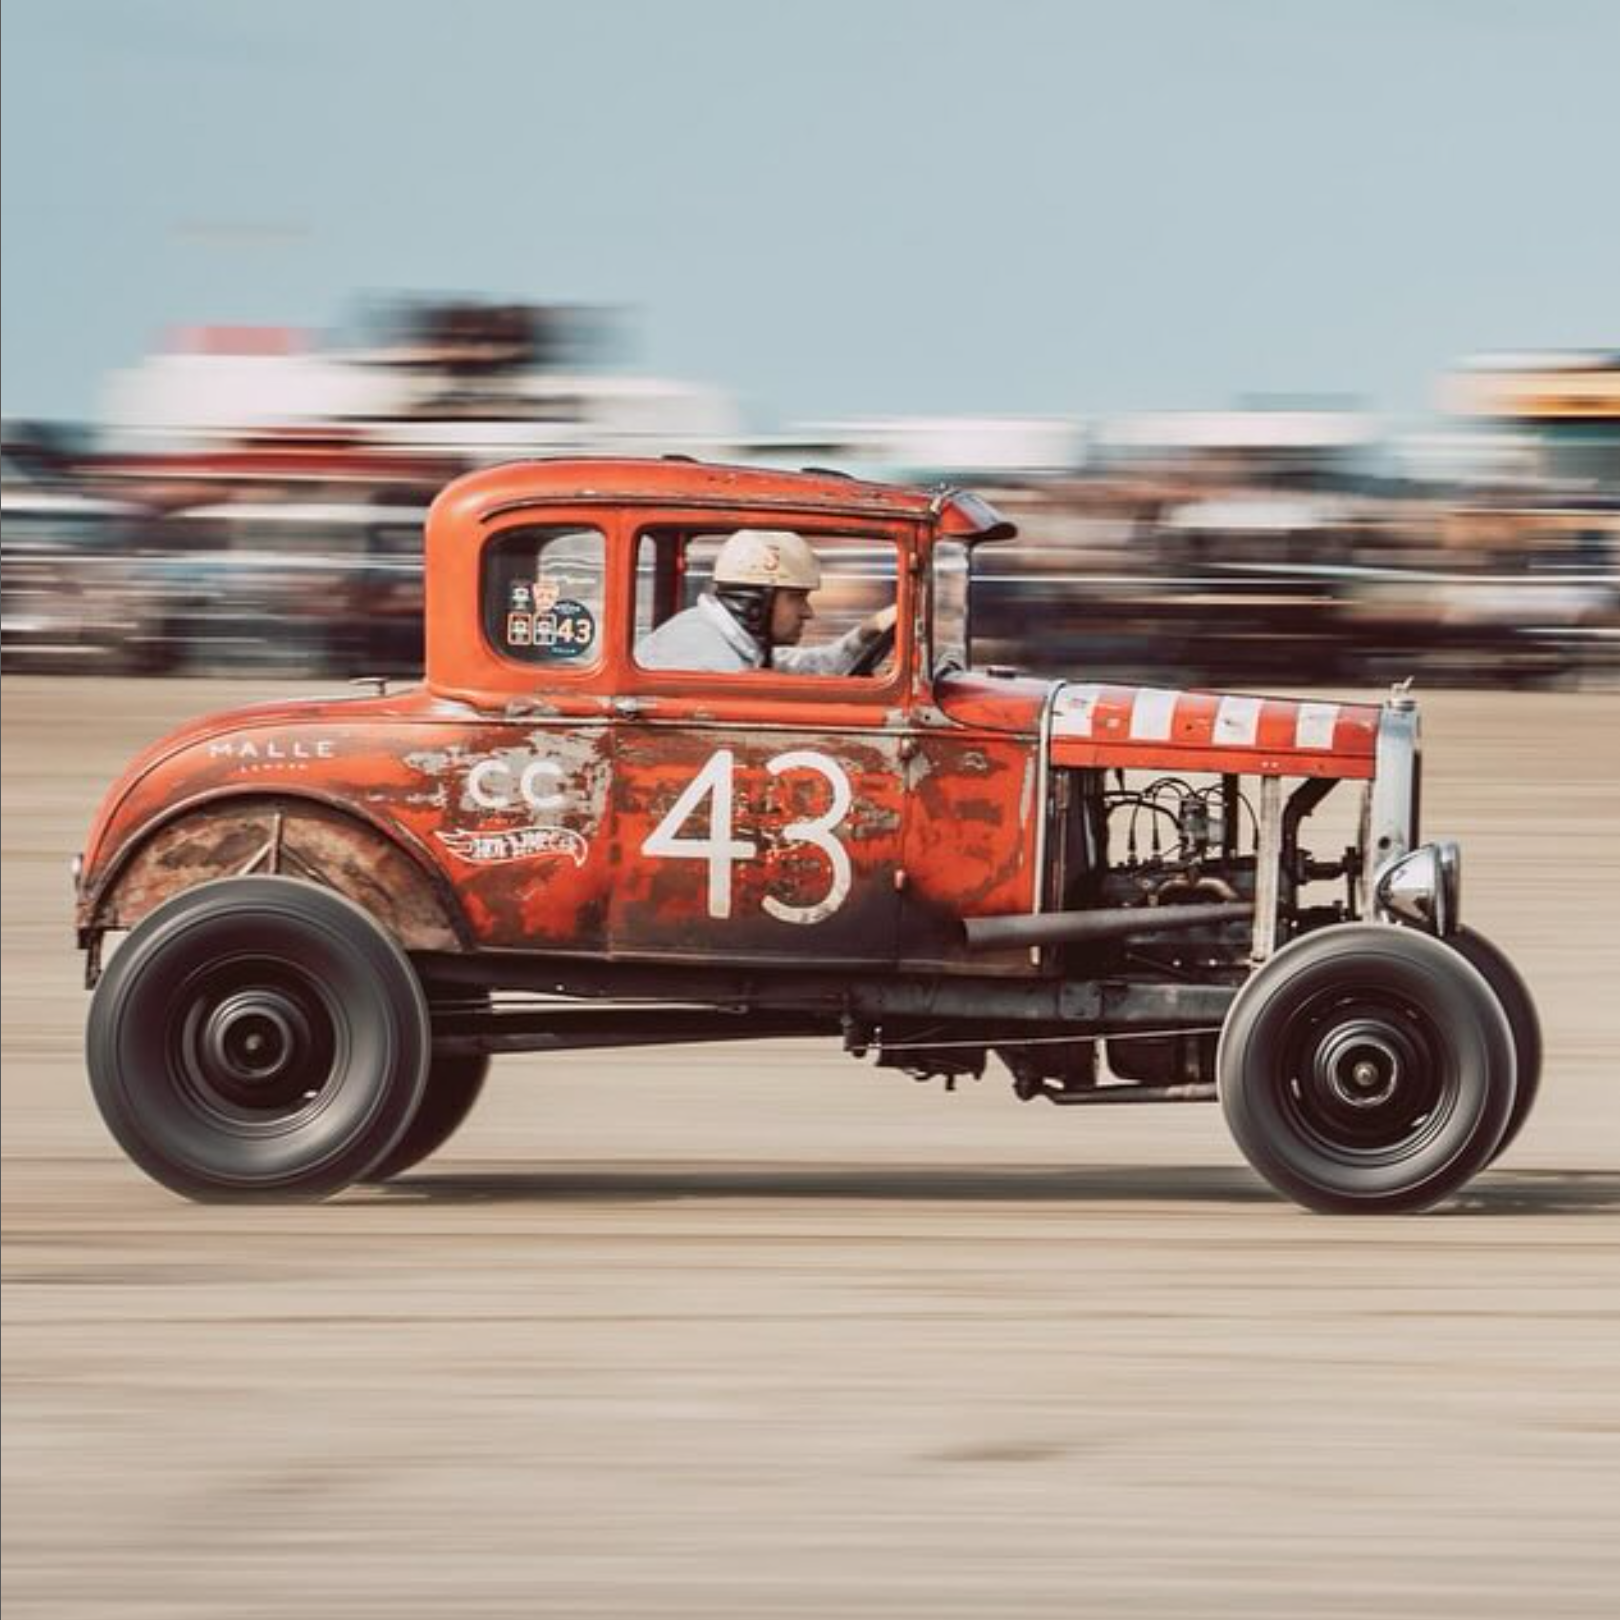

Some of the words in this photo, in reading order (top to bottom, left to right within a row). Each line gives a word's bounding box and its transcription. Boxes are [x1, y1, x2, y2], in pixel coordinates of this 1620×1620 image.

[557, 617, 592, 644] 43
[207, 740, 335, 759] MALLE
[468, 759, 563, 808] CC
[640, 748, 851, 925] 43
